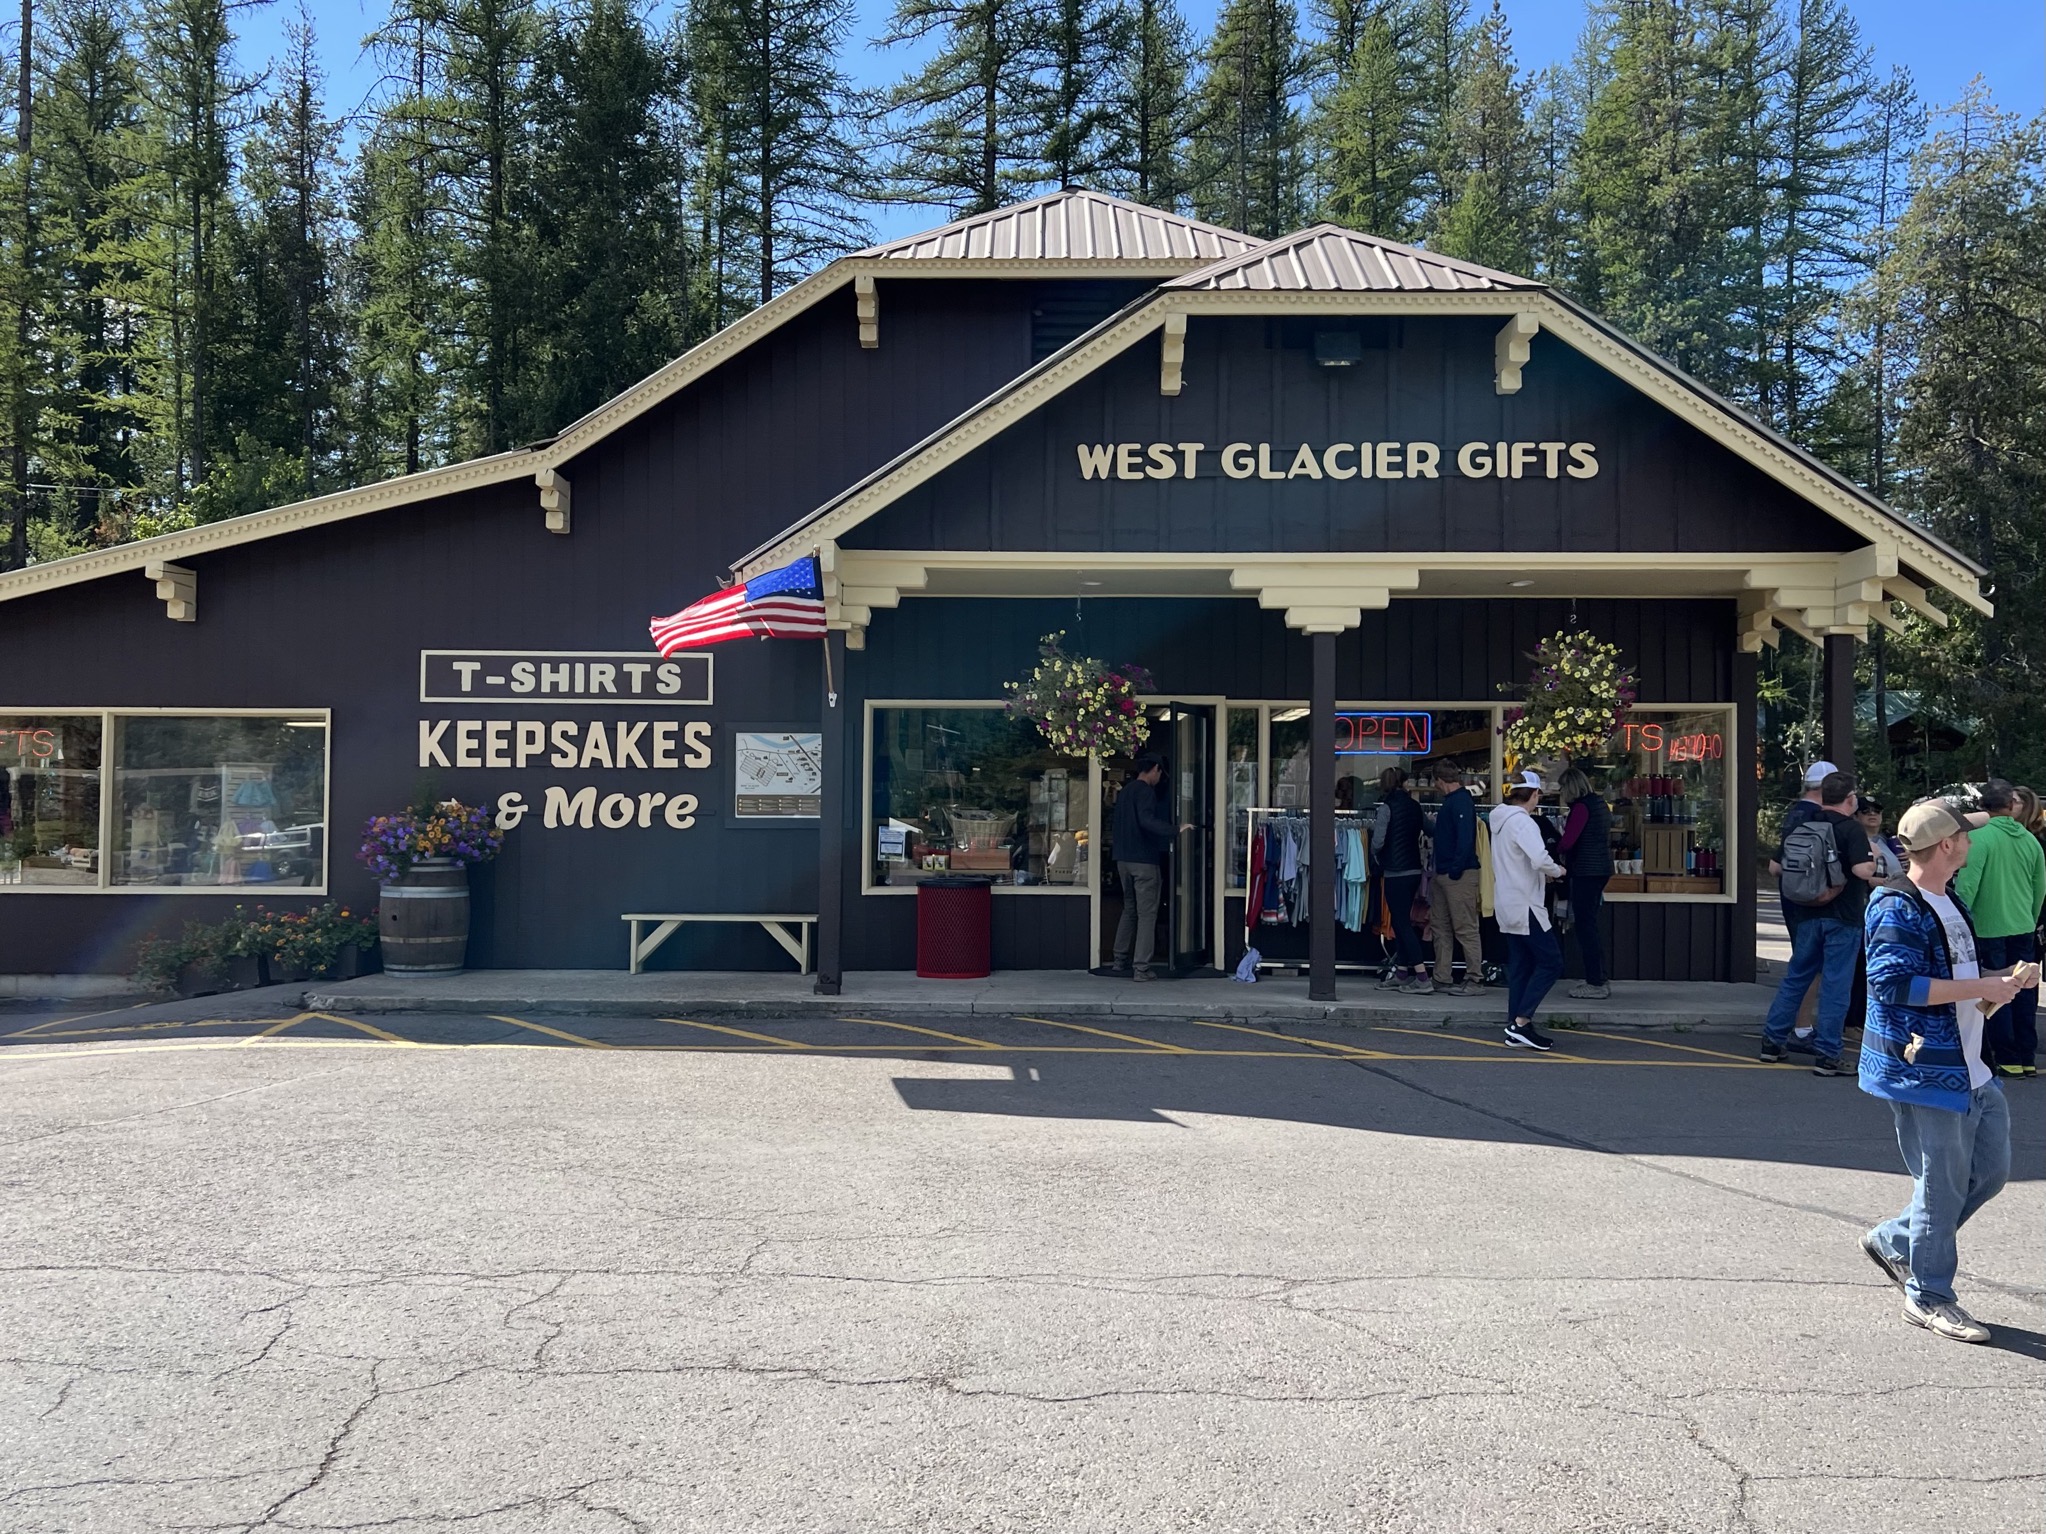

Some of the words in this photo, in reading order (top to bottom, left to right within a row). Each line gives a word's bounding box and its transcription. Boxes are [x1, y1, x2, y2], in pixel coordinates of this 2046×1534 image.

[1077, 442, 1205, 480] WEST
[1220, 441, 1441, 480] GLACIER
[1457, 441, 1599, 479] GIFTS
[452, 661, 682, 695] T-SHIRTS
[419, 719, 712, 769] KEEPSAKES
[1335, 716, 1427, 750] OPEN
[494, 791, 529, 830] &
[543, 786, 699, 830] More
